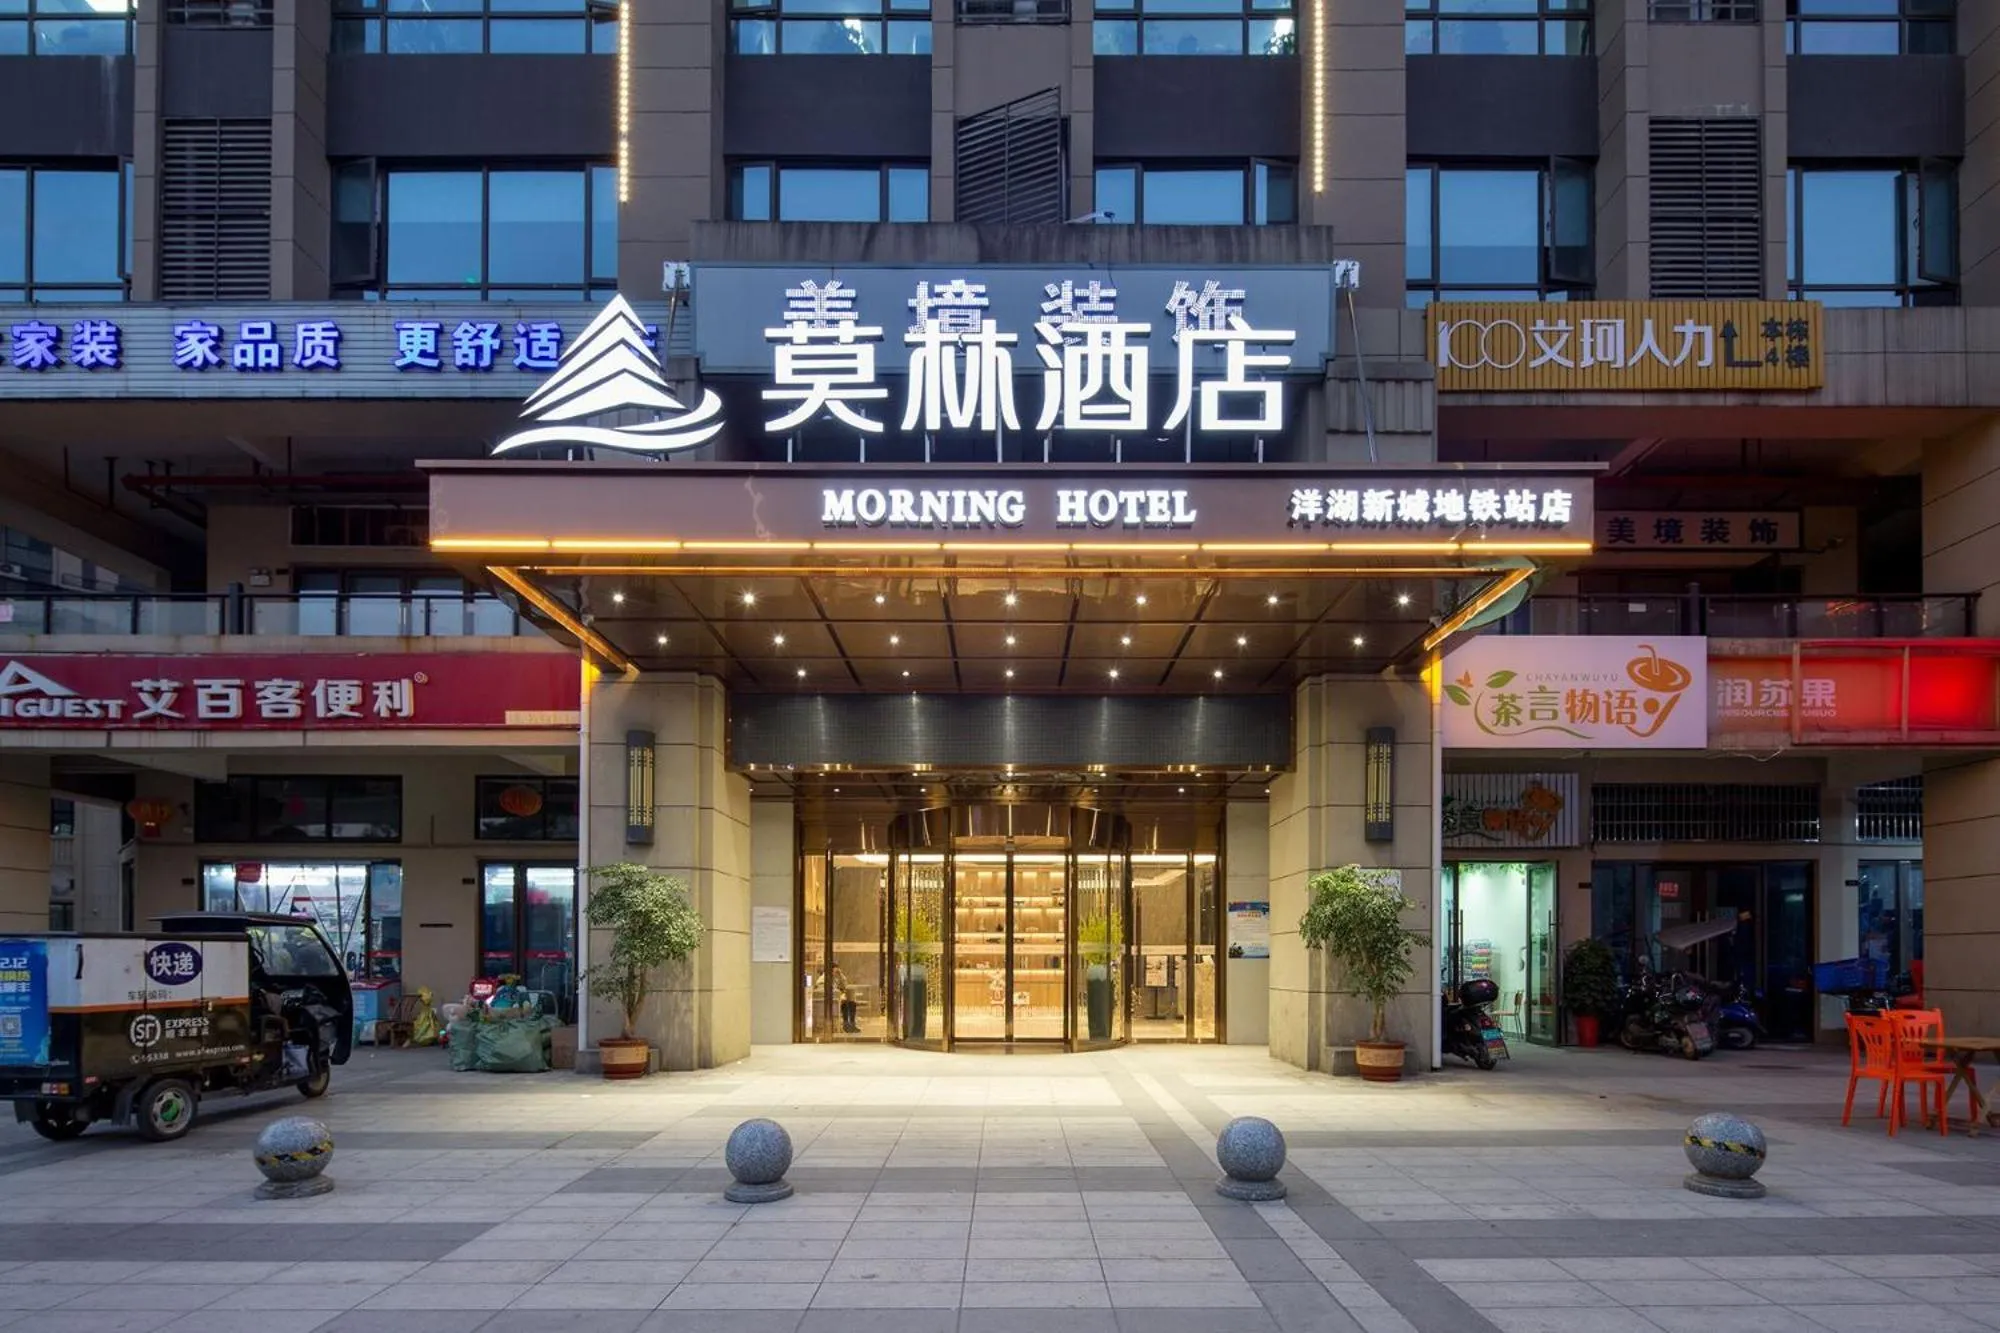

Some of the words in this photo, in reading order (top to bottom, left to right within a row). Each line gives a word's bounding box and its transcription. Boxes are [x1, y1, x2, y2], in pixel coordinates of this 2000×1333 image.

[174, 320, 342, 370] 家品质
[394, 321, 562, 370] 更舒适
[1529, 319, 1714, 369] 艾珂人力
[762, 314, 1296, 432] 莫林酒店
[821, 489, 1027, 527] MORNING
[1055, 490, 1198, 527] HOTEL
[1290, 488, 1572, 524] 洋湖新城地铁站店
[1606, 516, 1779, 545] 美境装饰
[1526, 673, 1619, 682] CHAYANWUYU
[131, 677, 416, 719] 艾百客便利
[1490, 685, 1638, 727] 茶言物语
[150, 951, 195, 977] 快递
[165, 1016, 210, 1028] EXPRESS
